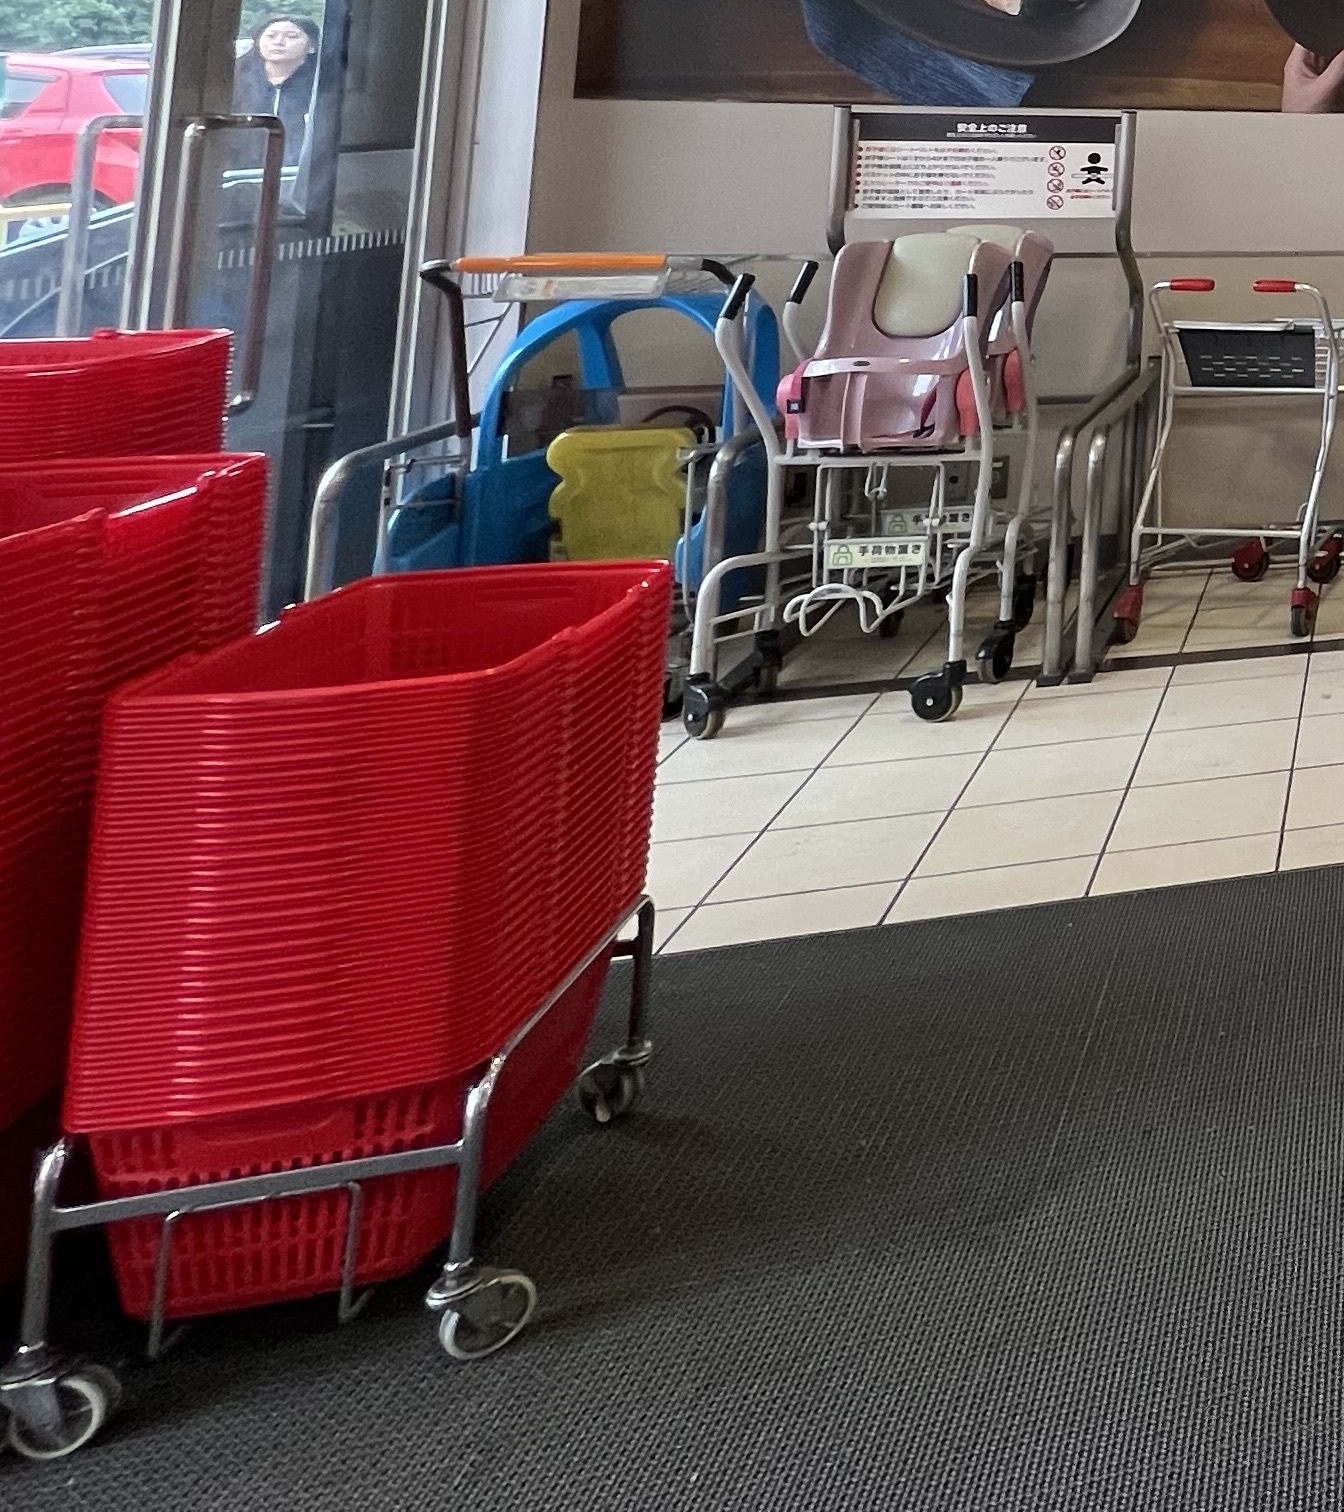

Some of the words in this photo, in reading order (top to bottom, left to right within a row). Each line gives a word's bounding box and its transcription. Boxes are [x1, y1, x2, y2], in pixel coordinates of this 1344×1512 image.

[857, 544, 922, 557] 手荷物置き
